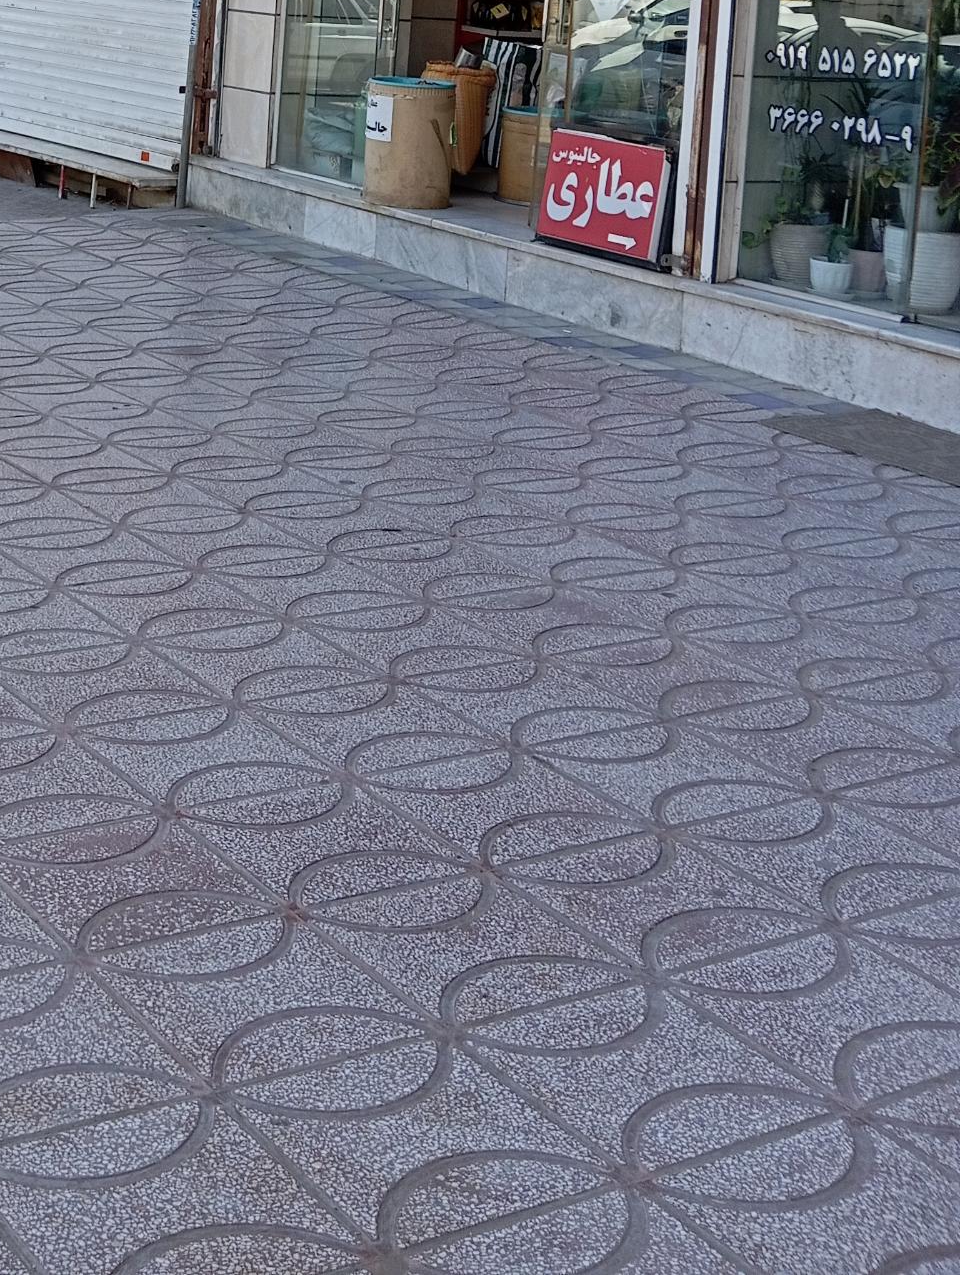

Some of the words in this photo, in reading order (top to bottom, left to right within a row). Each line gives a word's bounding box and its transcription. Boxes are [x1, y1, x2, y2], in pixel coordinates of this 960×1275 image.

[765, 42, 809, 70] ۰۹۱۹
[818, 47, 855, 74] ۵۱۵
[862, 48, 921, 80] ۶۵۲۲
[552, 146, 601, 169] جالینوس
[546, 158, 654, 228] عطاری
